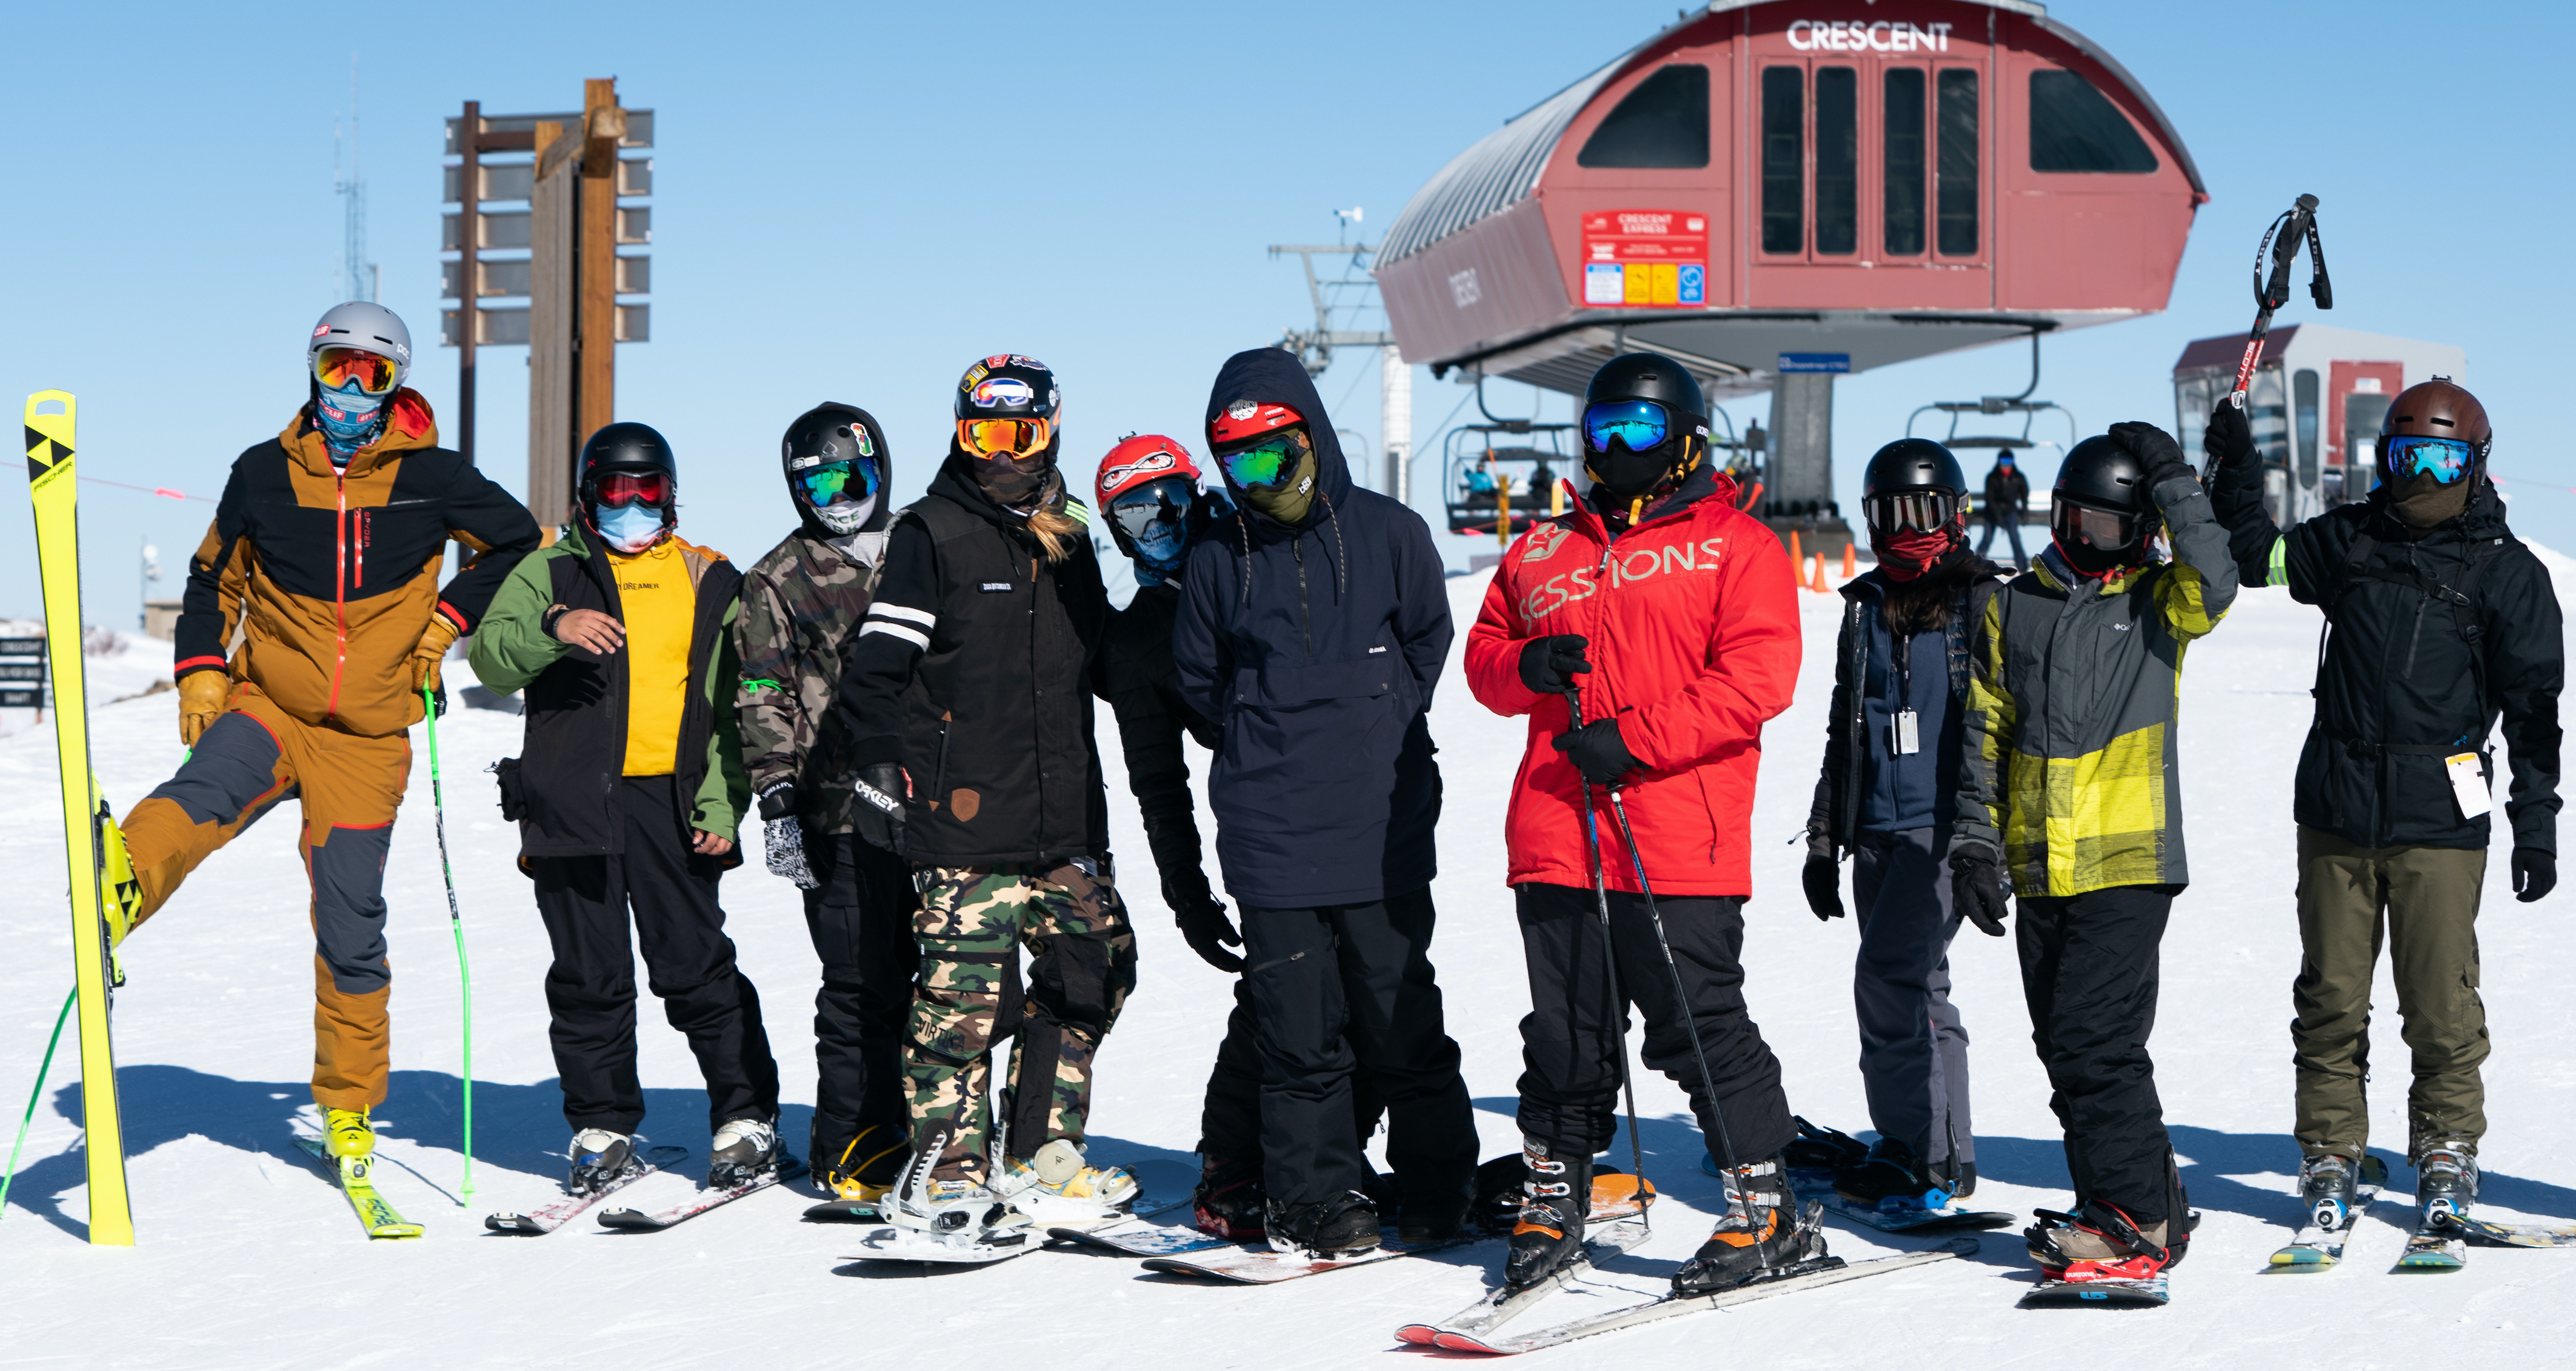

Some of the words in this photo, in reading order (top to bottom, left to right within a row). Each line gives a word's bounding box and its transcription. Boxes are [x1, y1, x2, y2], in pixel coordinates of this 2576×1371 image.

[1787, 19, 1953, 52] CRESCENT
[1618, 213, 1672, 225] CRESCENT
[2308, 225, 2321, 275] SCOTT
[2237, 340, 2256, 382] SCOTT
[34, 461, 72, 492] FISCHER
[813, 507, 860, 524] EACE
[820, 519, 859, 534] ARK
[1520, 538, 1723, 637] SESSIONS
[855, 779, 899, 812] OAKLEY
